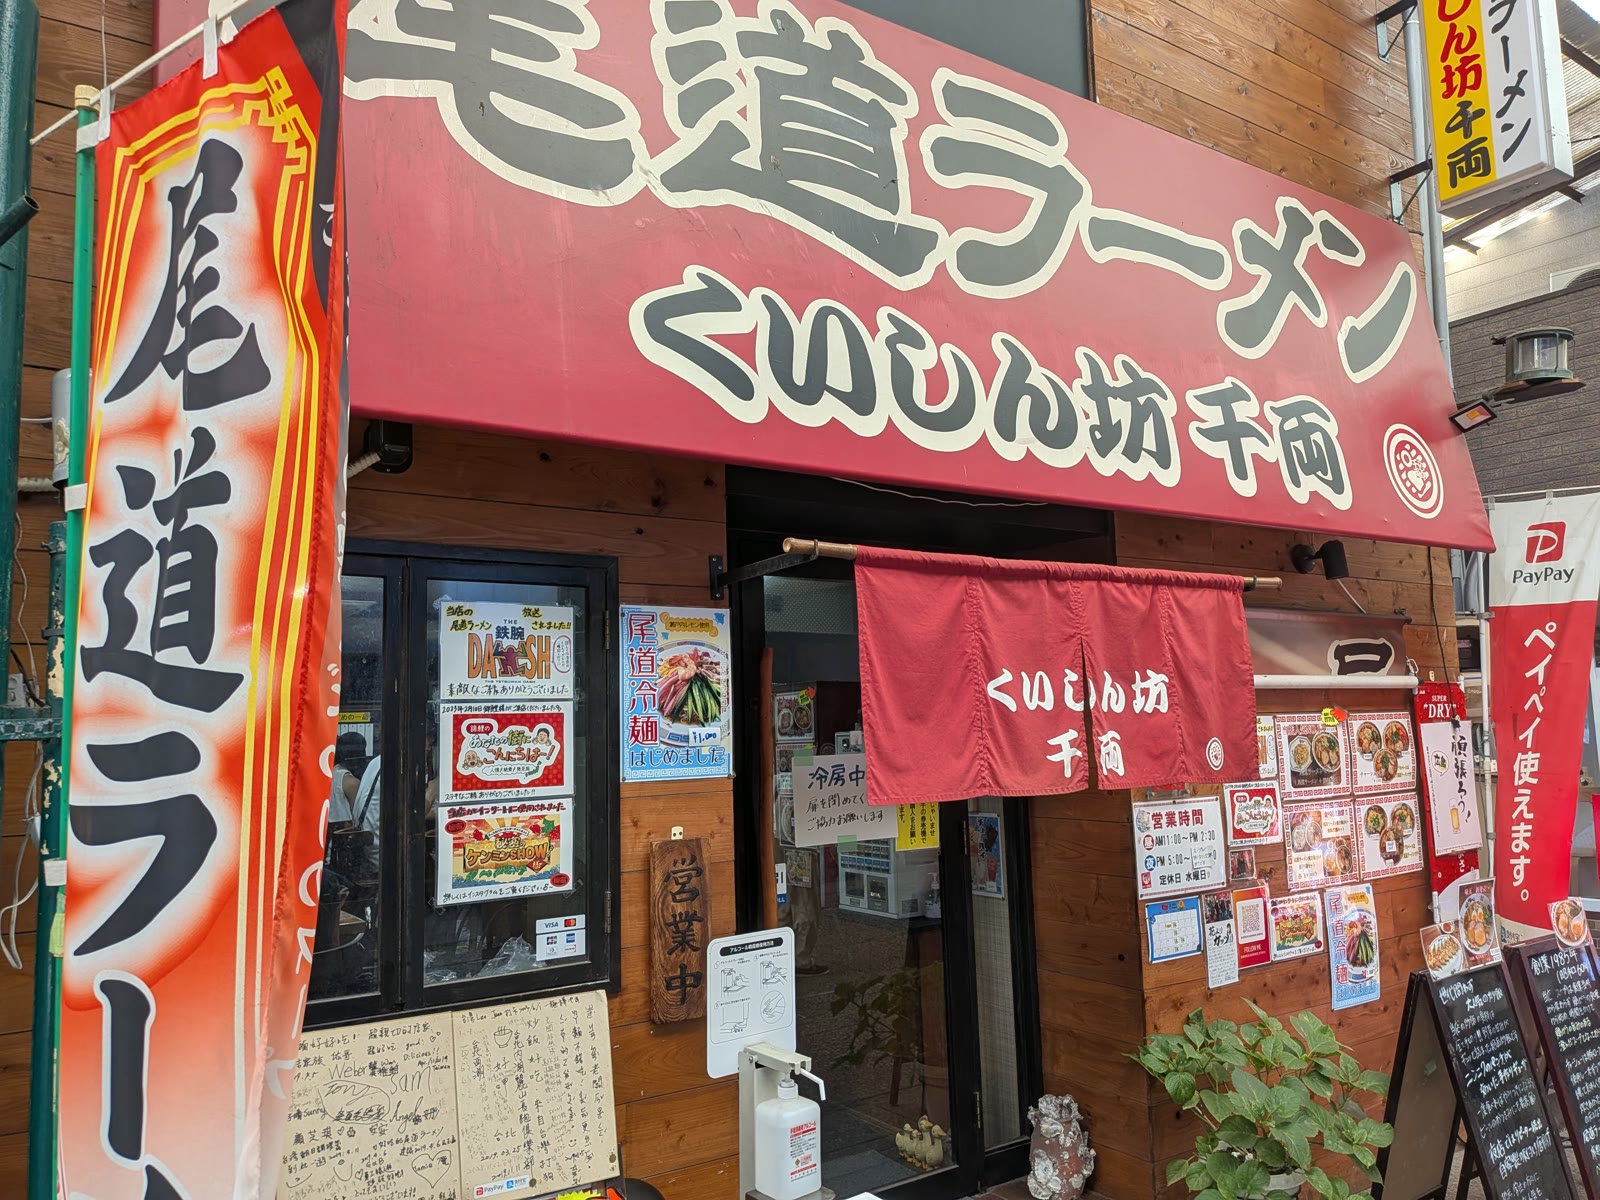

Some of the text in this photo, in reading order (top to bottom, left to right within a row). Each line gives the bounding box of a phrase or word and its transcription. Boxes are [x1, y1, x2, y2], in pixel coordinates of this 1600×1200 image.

[629, 265, 1353, 510] くいしん坊 千両
[1512, 566, 1575, 586] PayPay
[446, 605, 473, 617] 当店の
[450, 619, 492, 632] 尾道ラーメン
[495, 626, 525, 640] 鉄腕
[69, 138, 272, 1200] 尾道ラー
[628, 613, 659, 746] 尾道冷麺
[986, 668, 1170, 714] くいしん坊
[469, 729, 532, 749] あなたの街に
[631, 748, 726, 767] はじめました
[1045, 728, 1125, 779] 千両
[1509, 621, 1557, 902] ペイペイ使えます。
[807, 764, 865, 790] 冷房中
[807, 810, 884, 831] ご協力お願いします
[1151, 809, 1204, 830] 営業時間
[1201, 829, 1216, 842] 2:30
[465, 841, 549, 867] ケンミンSHOW
[1159, 869, 1207, 886] 定休日 水曜日
[544, 921, 559, 929] VISA
[664, 854, 704, 1005] 営業中
[328, 1062, 368, 1081] Weber
[303, 1106, 327, 1120] Sunny
[484, 1182, 504, 1193] PayPay
